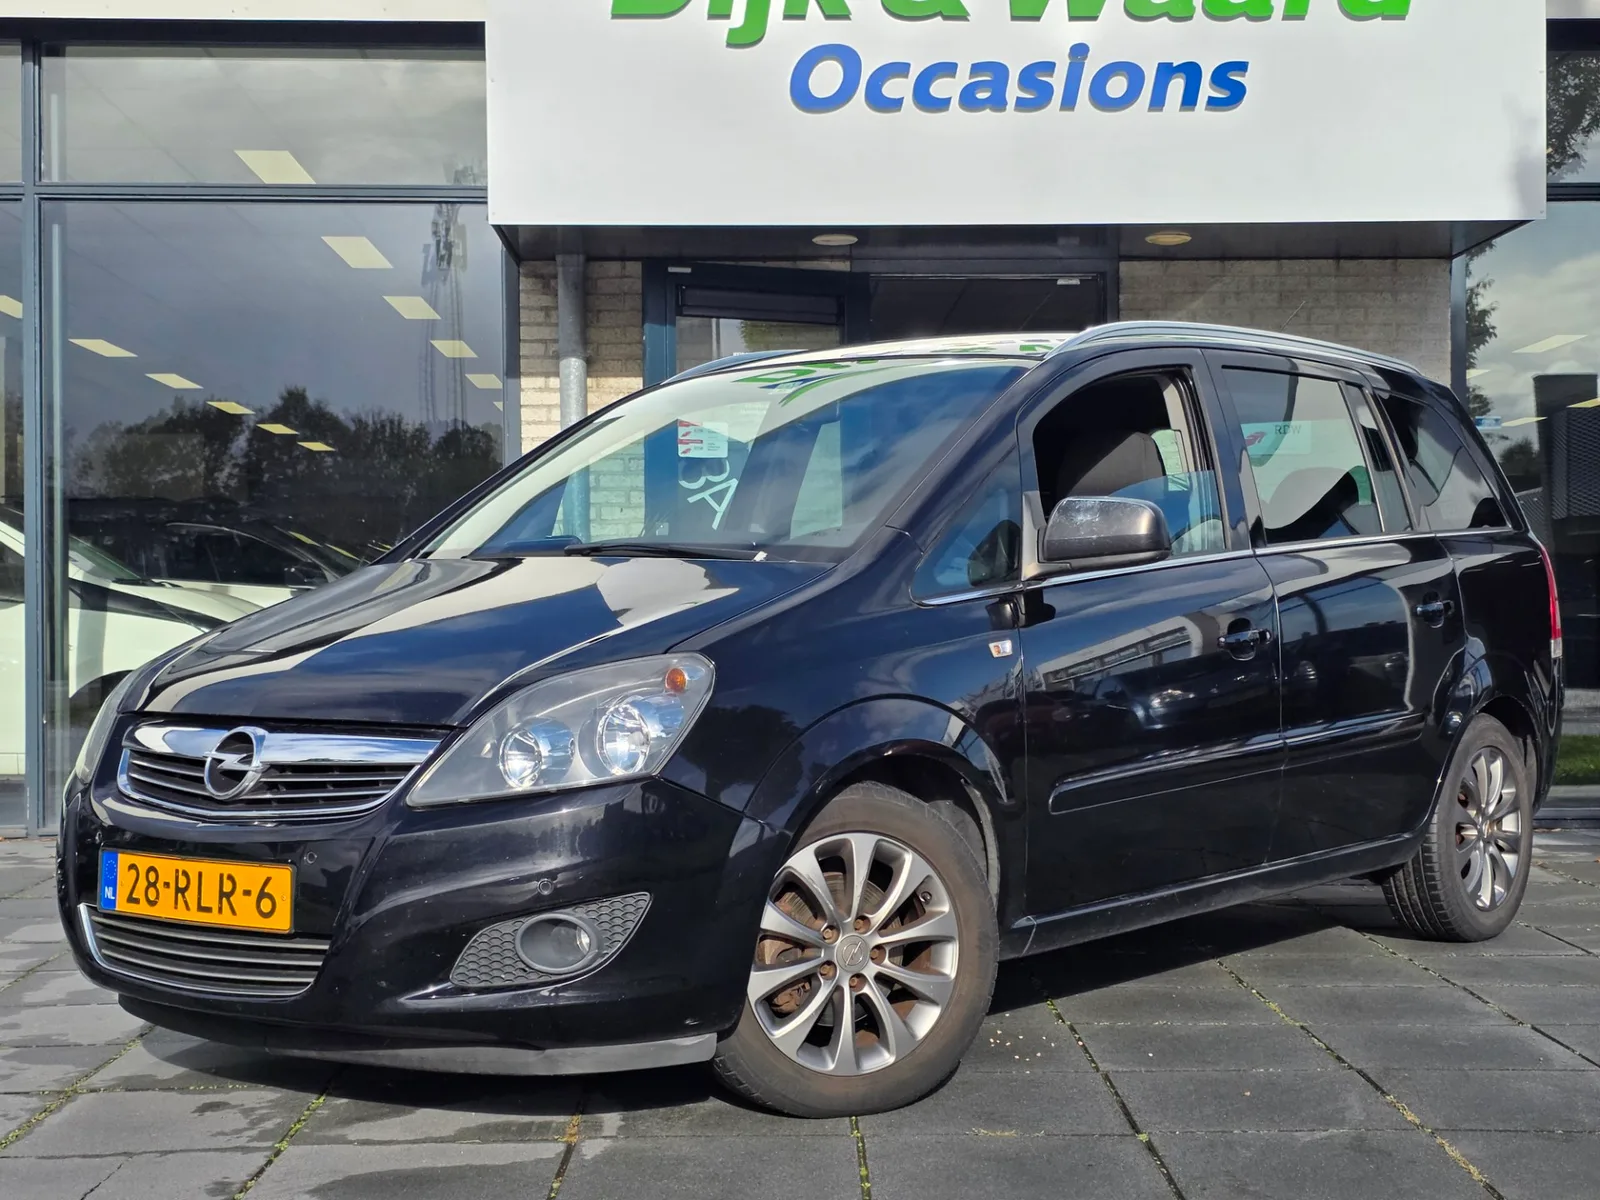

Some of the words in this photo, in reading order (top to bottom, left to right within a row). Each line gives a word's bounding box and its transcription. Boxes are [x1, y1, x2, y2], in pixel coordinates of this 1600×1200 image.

[789, 43, 1249, 113] Occasions
[104, 886, 116, 900] NL
[126, 862, 277, 919] 28-RLR-6
